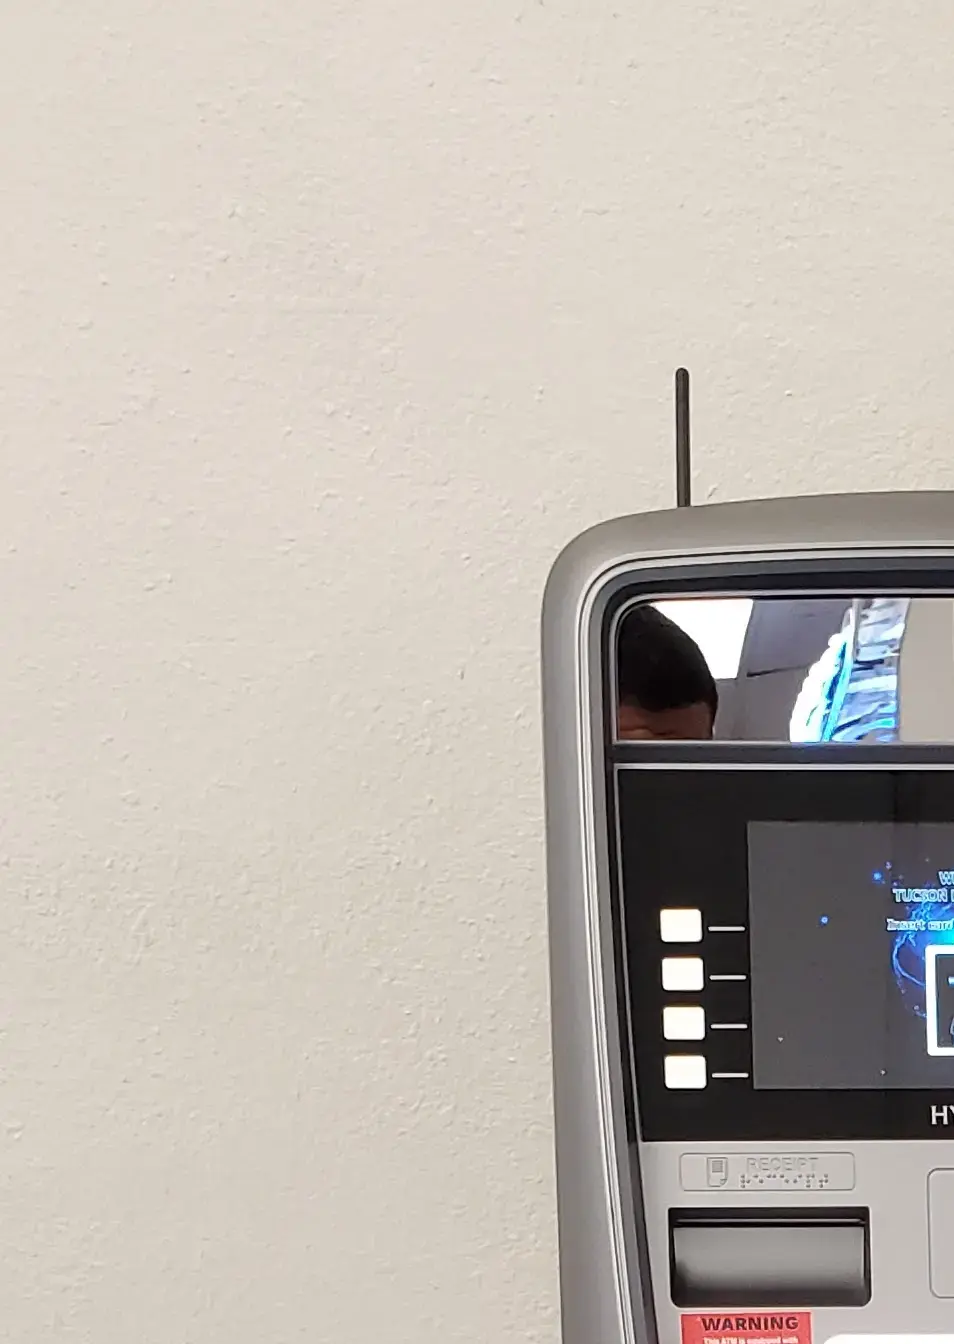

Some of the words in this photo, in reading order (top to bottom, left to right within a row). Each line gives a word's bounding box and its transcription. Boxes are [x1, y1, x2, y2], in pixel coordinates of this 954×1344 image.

[893, 888, 948, 903] TUCSON
[886, 918, 926, 931] Insert
[928, 918, 954, 931] card
[747, 1157, 819, 1172] RECEIPT
[701, 1316, 799, 1331] WARNING
[703, 1337, 720, 1344] This
[721, 1337, 738, 1344] ATM
[739, 1337, 746, 1344] is
[782, 1336, 799, 1344] with
